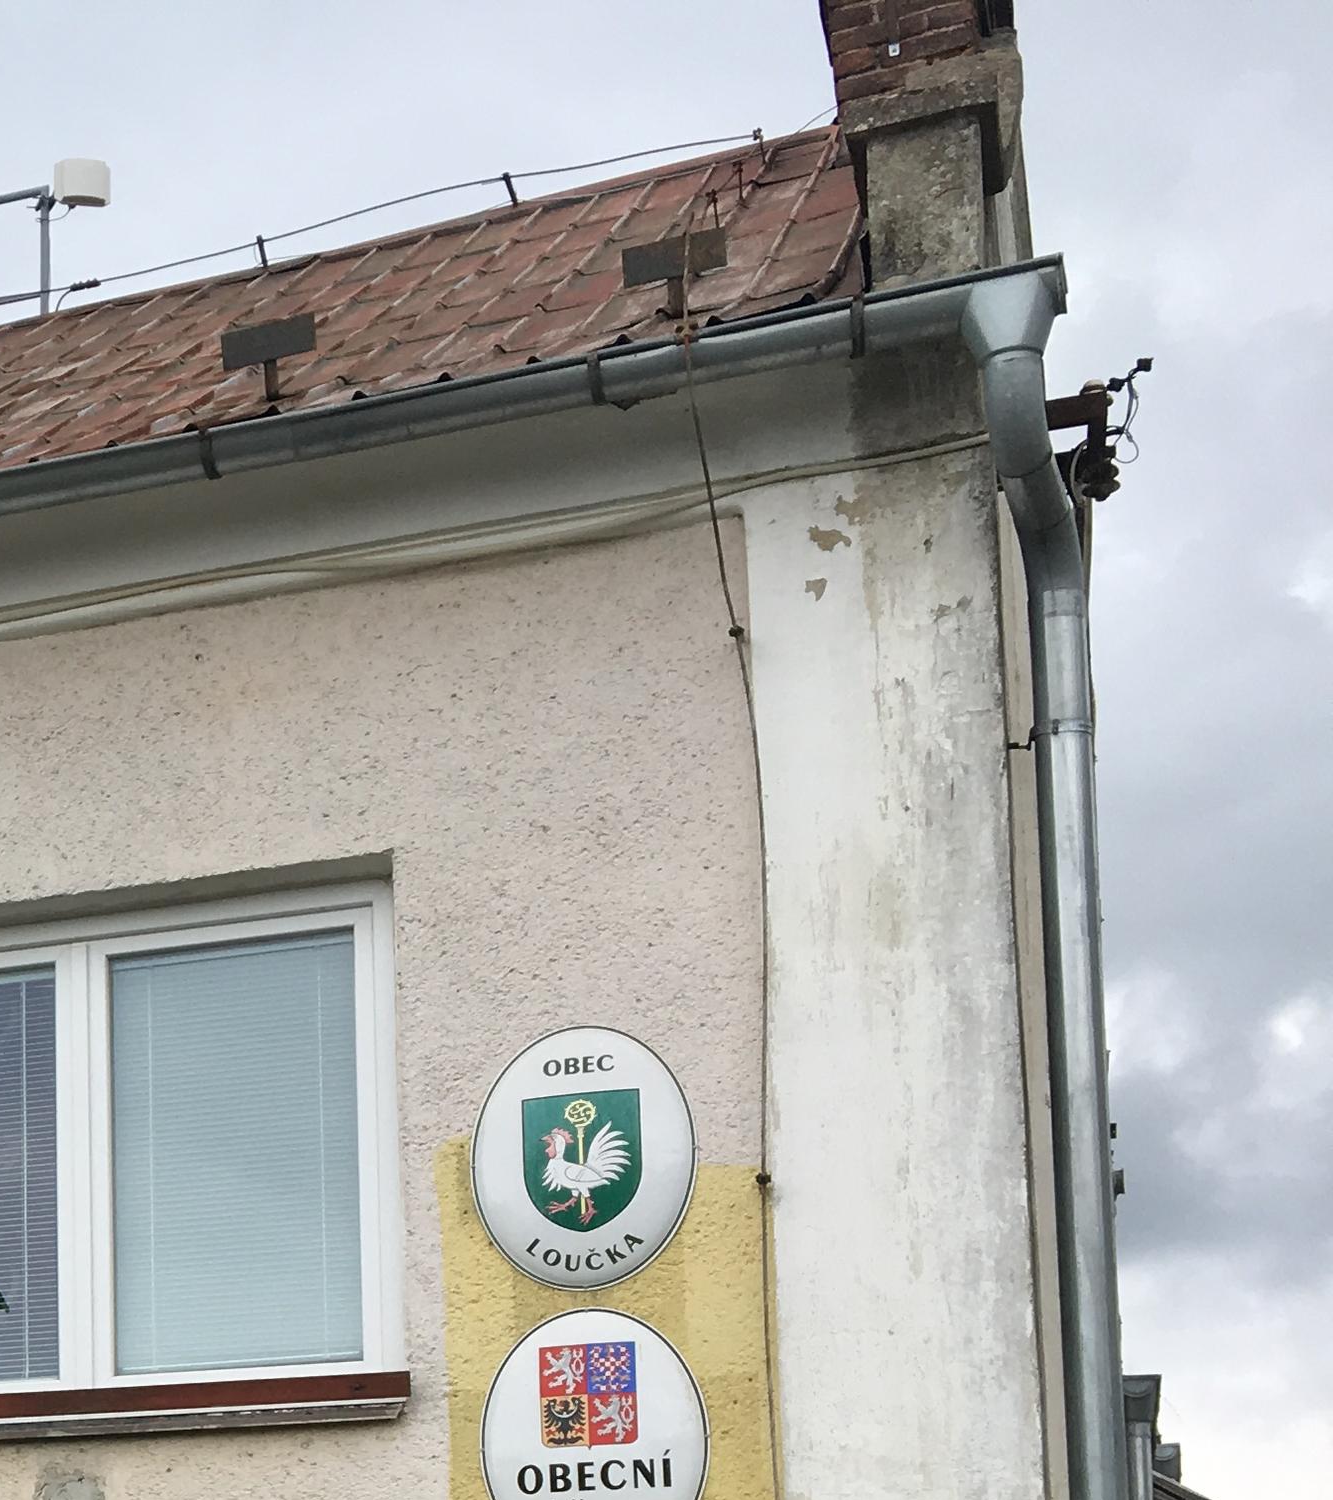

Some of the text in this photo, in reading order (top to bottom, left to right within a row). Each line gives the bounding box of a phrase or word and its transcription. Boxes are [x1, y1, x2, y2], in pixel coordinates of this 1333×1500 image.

[542, 1054, 615, 1077] OBEC
[525, 1232, 645, 1272] LOUČKA
[516, 1449, 673, 1495] OBECNÍ
